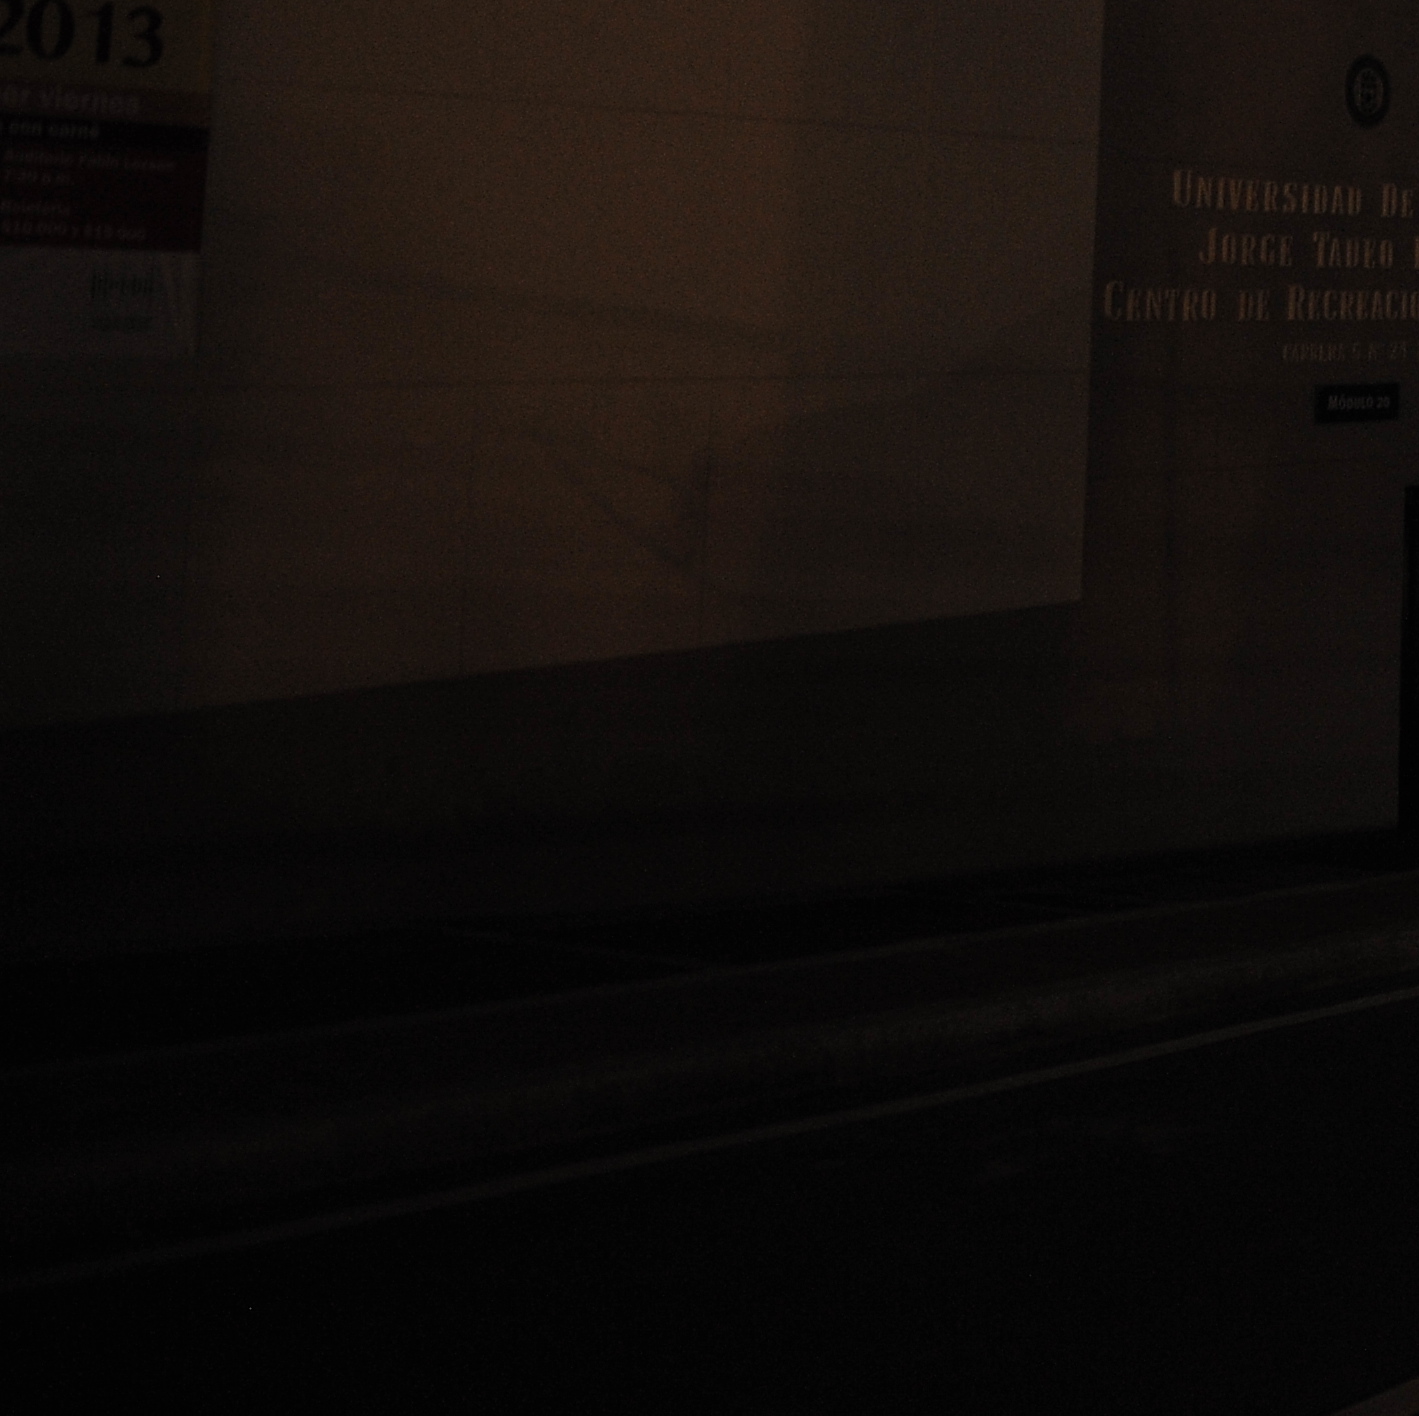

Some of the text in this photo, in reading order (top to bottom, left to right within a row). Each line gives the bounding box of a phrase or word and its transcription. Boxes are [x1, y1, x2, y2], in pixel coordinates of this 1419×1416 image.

[1172, 170, 1362, 217] UNIVERSIDAD
[1381, 183, 1415, 218] DE
[1199, 227, 1293, 268] JORGE
[1313, 230, 1394, 270] TADEO
[1103, 280, 1217, 322] CENTRO
[1237, 288, 1270, 322] DE
[1327, 393, 1374, 411] MÓDULO
